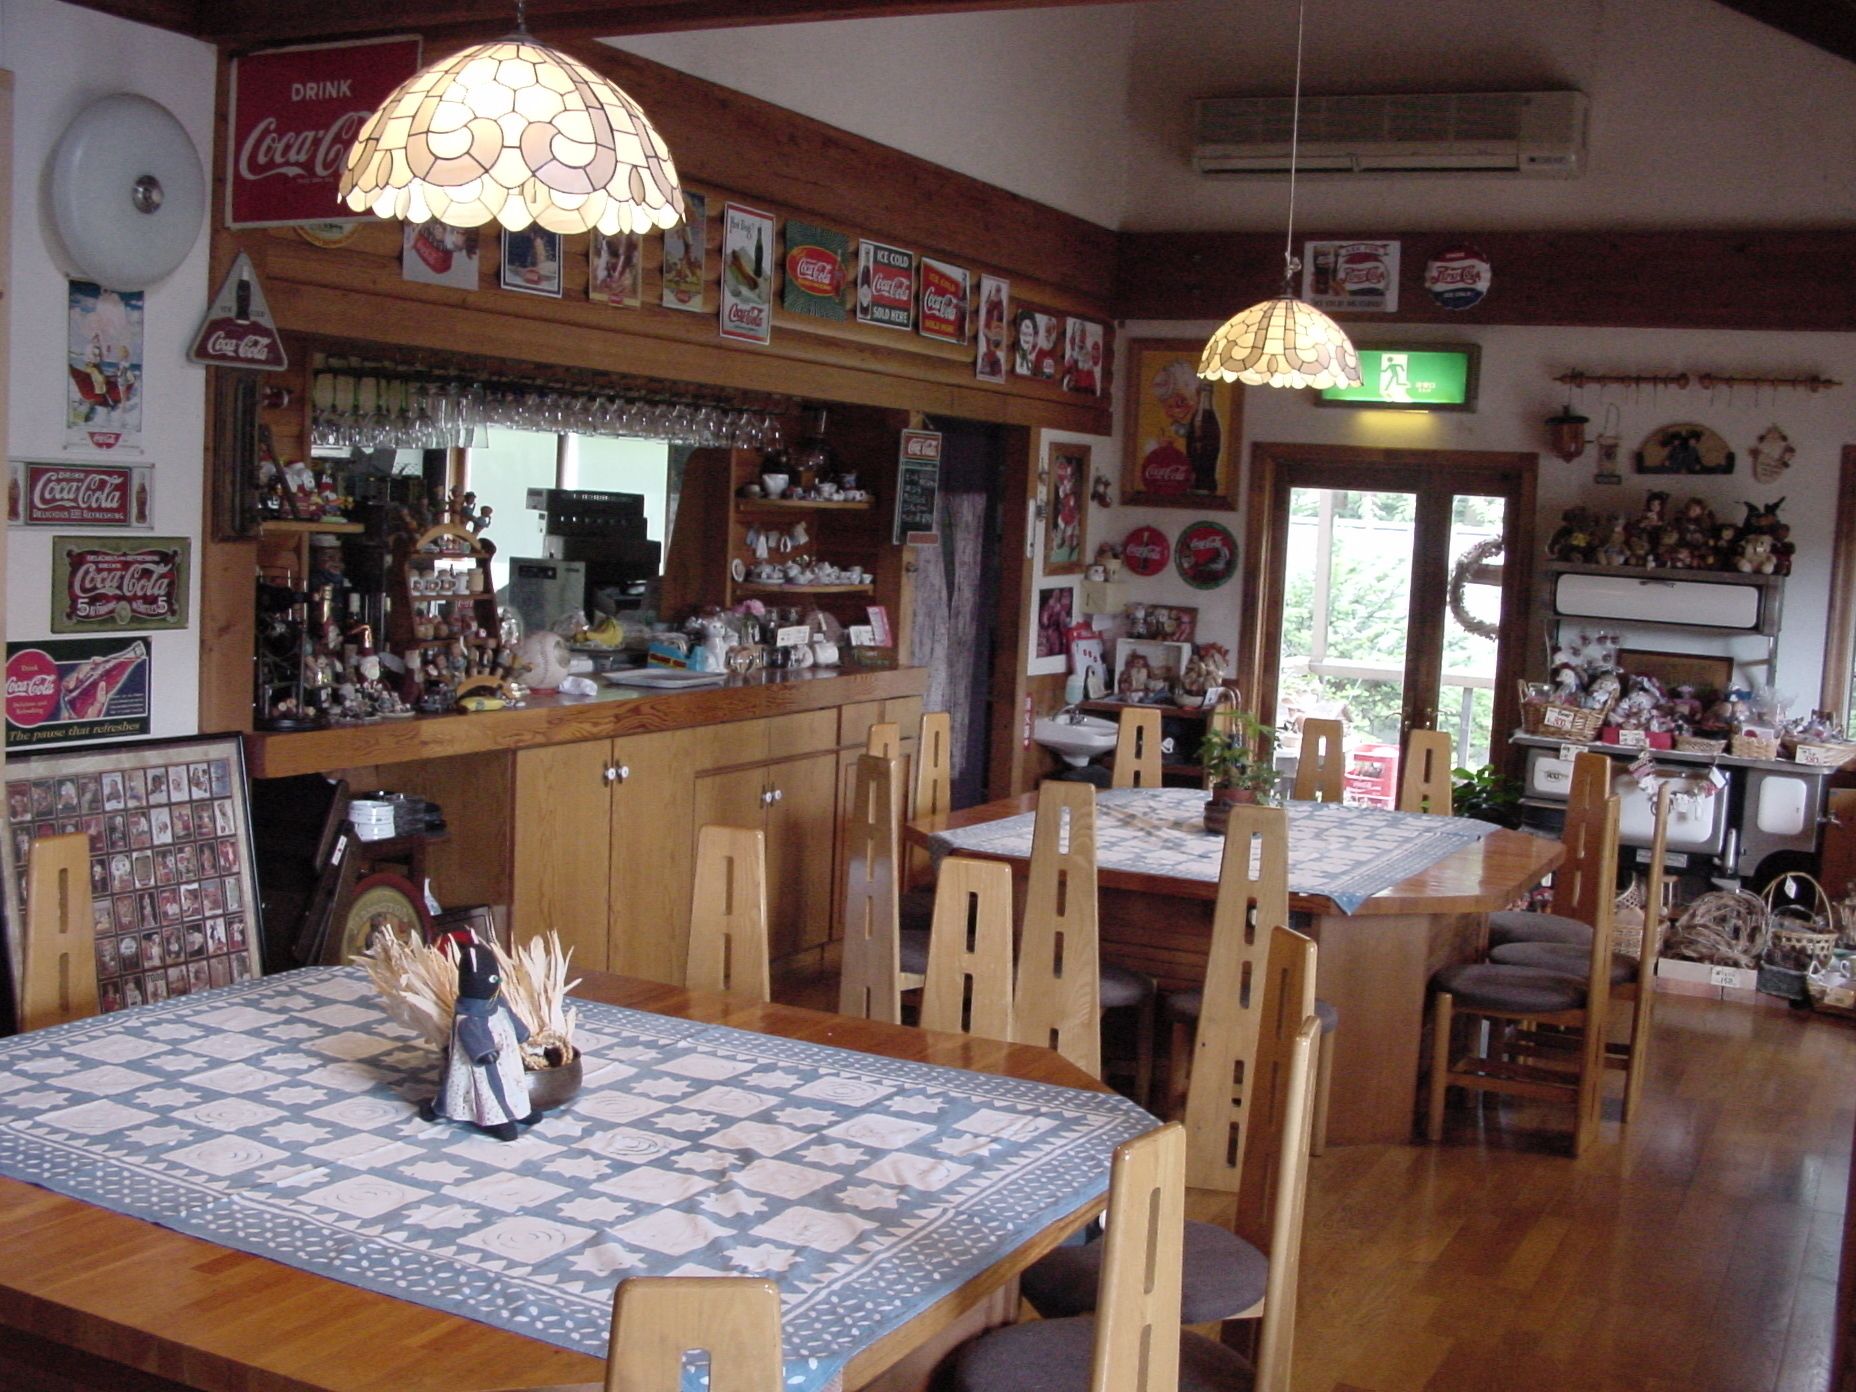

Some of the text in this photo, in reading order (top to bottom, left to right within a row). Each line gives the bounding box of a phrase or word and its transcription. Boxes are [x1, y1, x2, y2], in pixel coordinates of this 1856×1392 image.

[291, 79, 352, 102] DRINK
[239, 111, 372, 180] Coca-C
[878, 250, 909, 268] ICE COLD
[873, 274, 909, 300] Coca-Cola
[873, 307, 890, 321] SOLD
[208, 331, 271, 360] Coca-Cola
[33, 472, 124, 509] Coca-Cola
[74, 563, 172, 597] Coca-Cola
[6, 675, 56, 697] Coca-Cola
[9, 731, 30, 741] The
[33, 729, 66, 741] pause
[68, 725, 91, 736] that
[93, 721, 140, 735] refreshes
